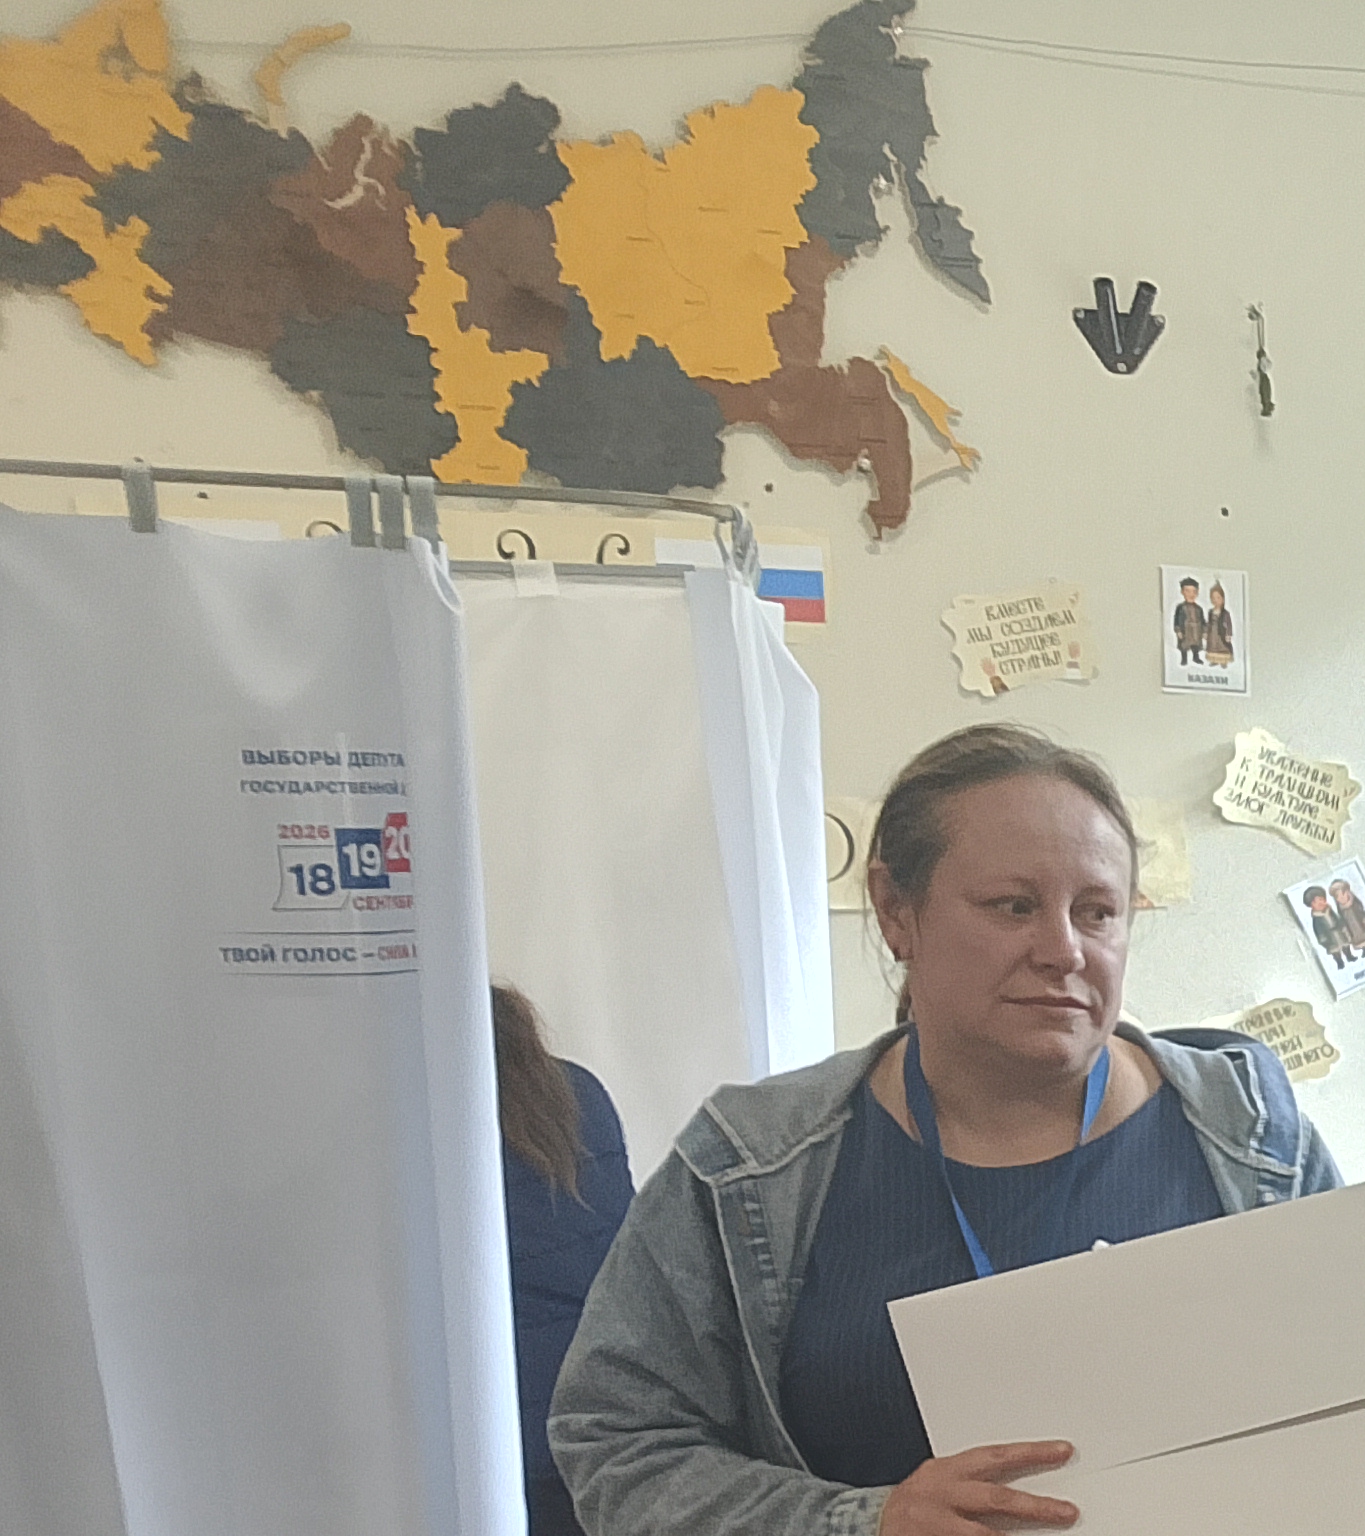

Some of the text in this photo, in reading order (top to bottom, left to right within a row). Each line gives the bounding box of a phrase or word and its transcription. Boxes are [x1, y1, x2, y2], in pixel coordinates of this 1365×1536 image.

[241, 750, 342, 767] ВЫБОРЫ
[240, 780, 399, 795] ГОСУДАРСТВЕННОЙ
[277, 824, 331, 840] 2026
[287, 863, 336, 897] 18
[341, 843, 382, 878] 19
[219, 943, 275, 963] ТВОЙ
[282, 947, 358, 963] ГОЛОС
